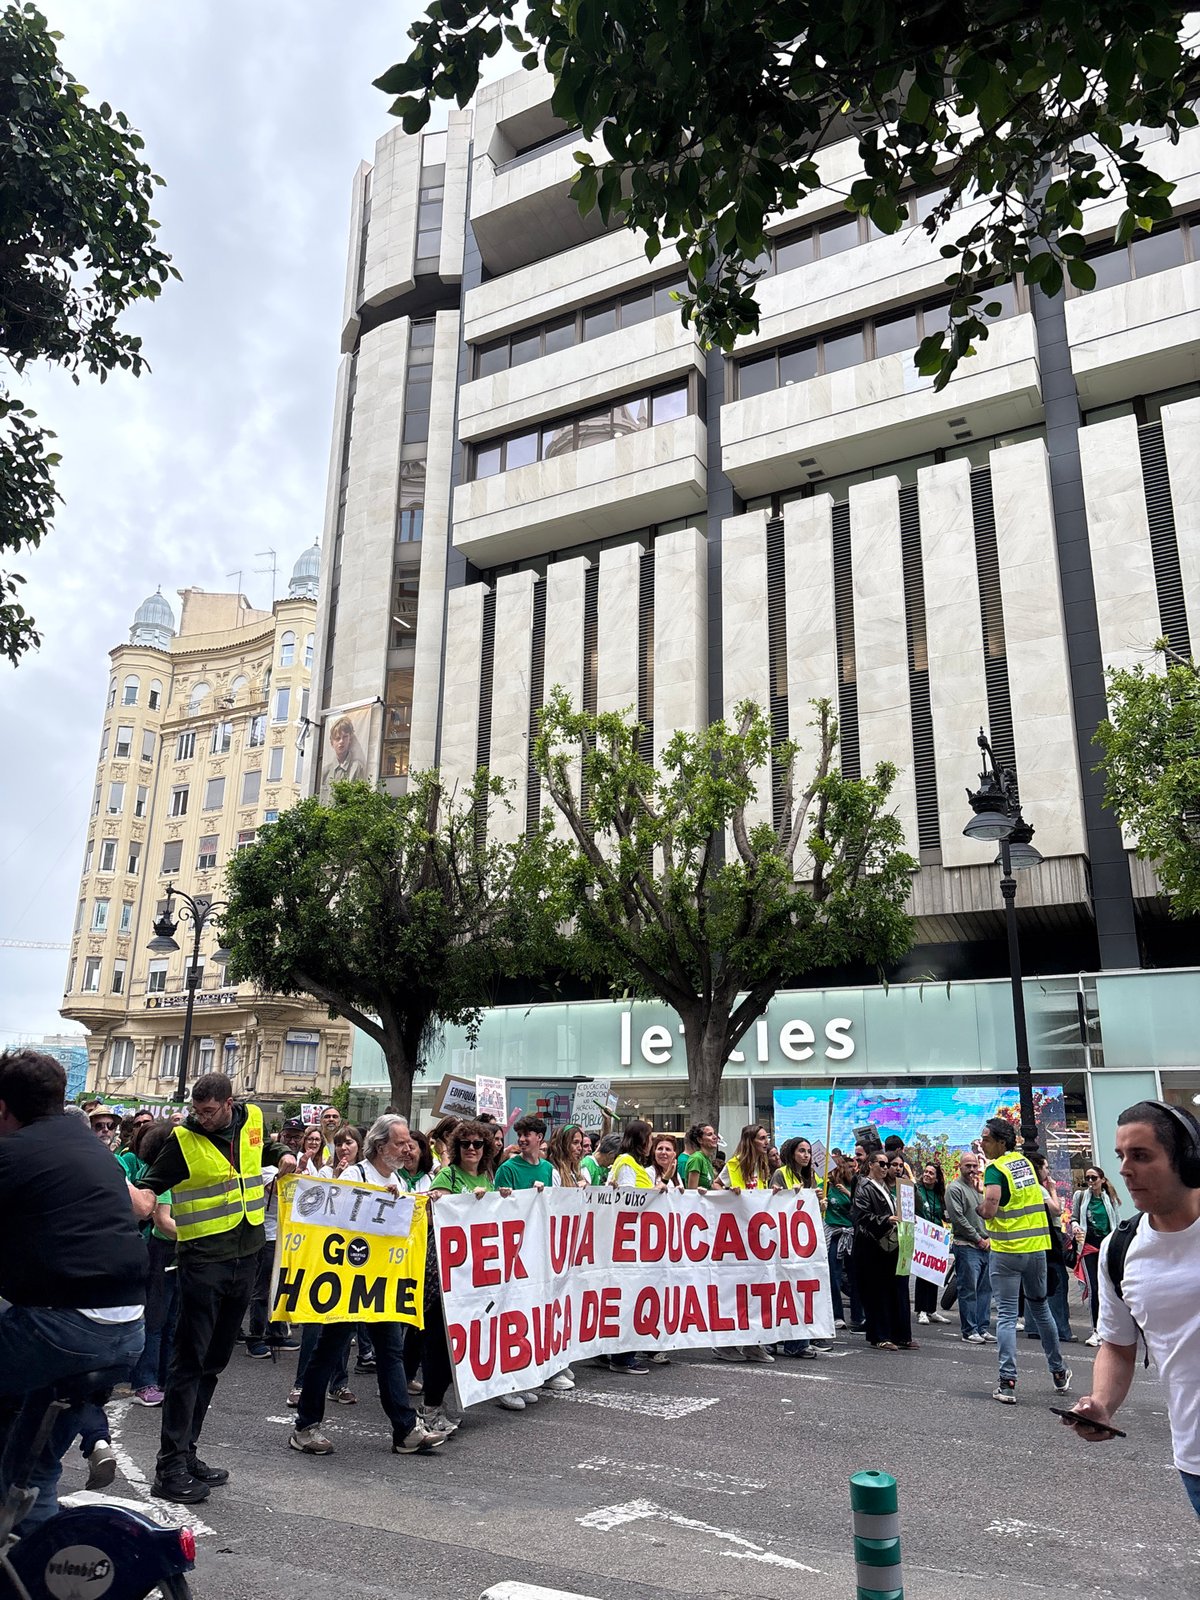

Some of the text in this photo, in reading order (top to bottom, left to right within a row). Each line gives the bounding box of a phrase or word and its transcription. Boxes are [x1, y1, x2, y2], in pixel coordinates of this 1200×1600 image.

[621, 1005, 855, 1065] leies
[450, 1087, 477, 1103] EDIFIQUA
[440, 1219, 529, 1293] PER
[612, 1200, 818, 1263] EDUCACIÓ
[273, 1267, 418, 1316] HOME
[447, 1279, 820, 1381] PÚBLICA DE QUALITAT
